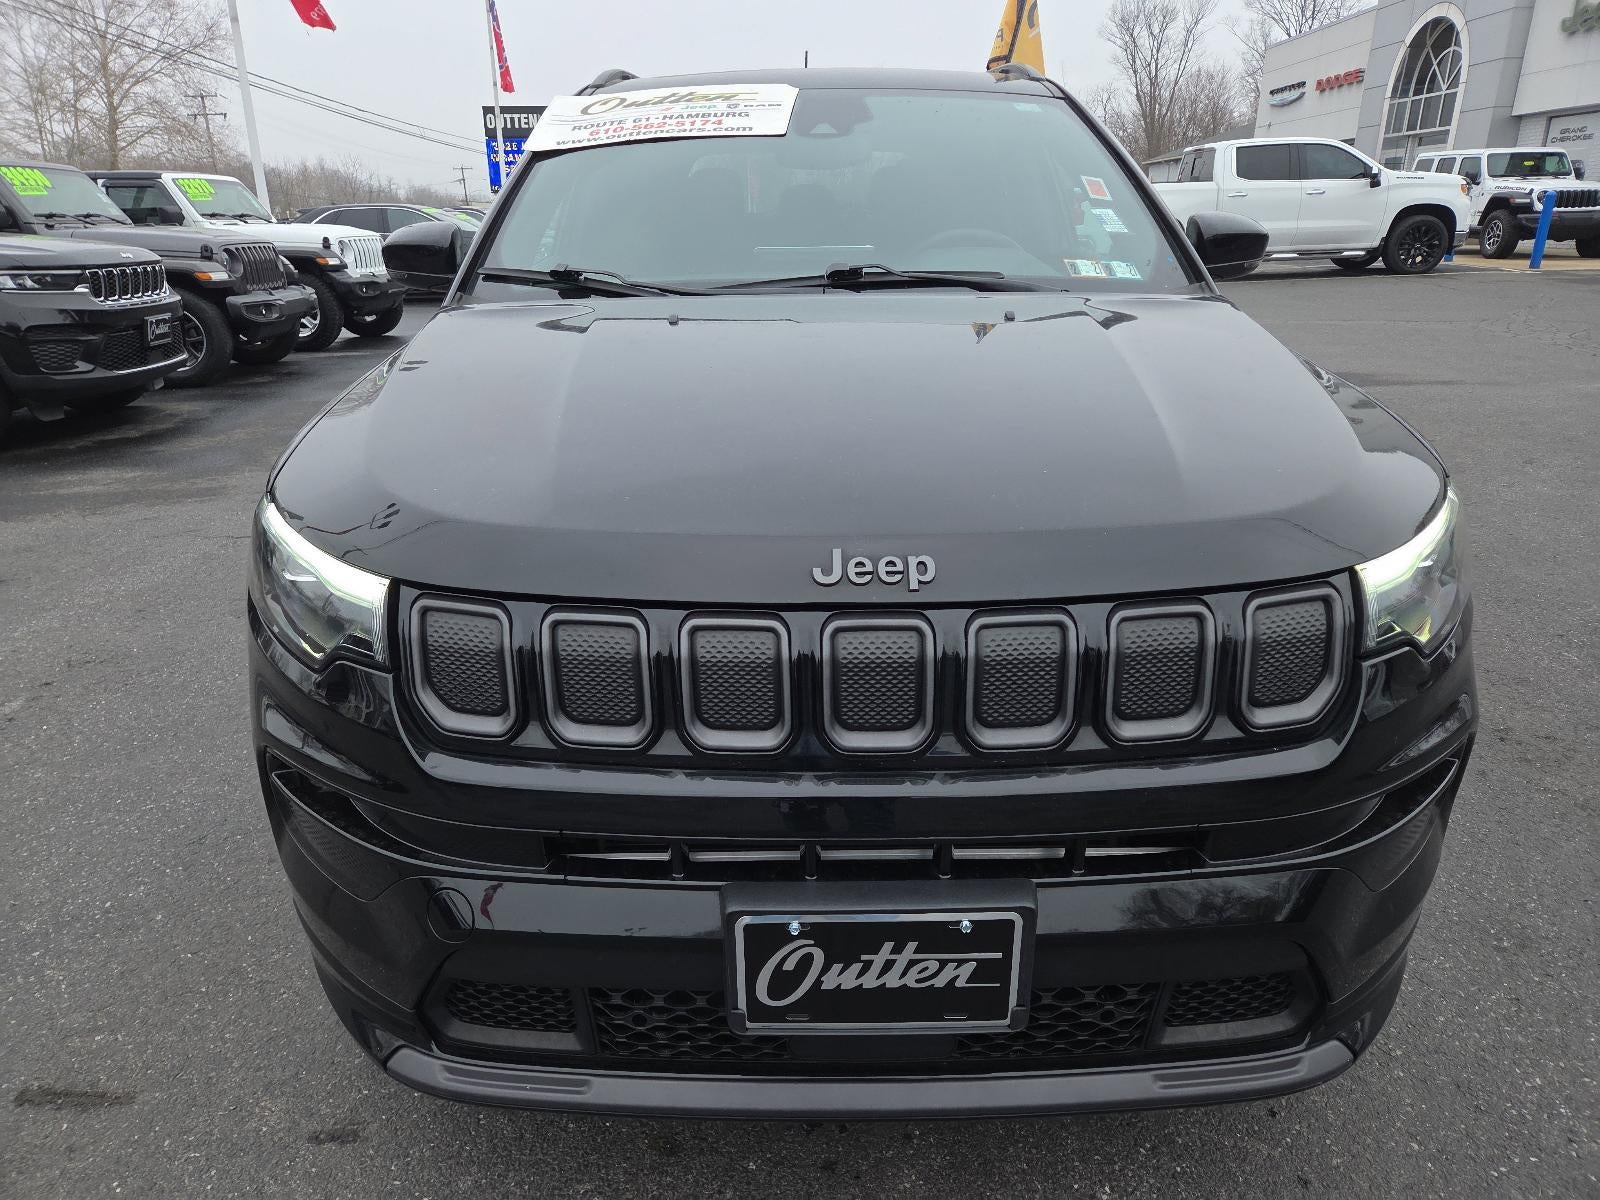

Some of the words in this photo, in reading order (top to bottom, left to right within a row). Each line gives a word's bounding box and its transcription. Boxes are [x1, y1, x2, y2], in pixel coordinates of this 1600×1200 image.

[1315, 68, 1365, 93] DODGE
[580, 91, 759, 115] Outten
[571, 118, 629, 131] ROUTE
[632, 116, 651, 124] 61
[661, 111, 750, 121] HAMBURG
[588, 119, 724, 137] 610-562-5174
[1560, 125, 1588, 135] GRAND
[556, 126, 753, 146] www.outtencars.com
[1551, 133, 1595, 143] CHEROKEE
[812, 548, 936, 592] Jeep
[755, 939, 1003, 1007] Outten
